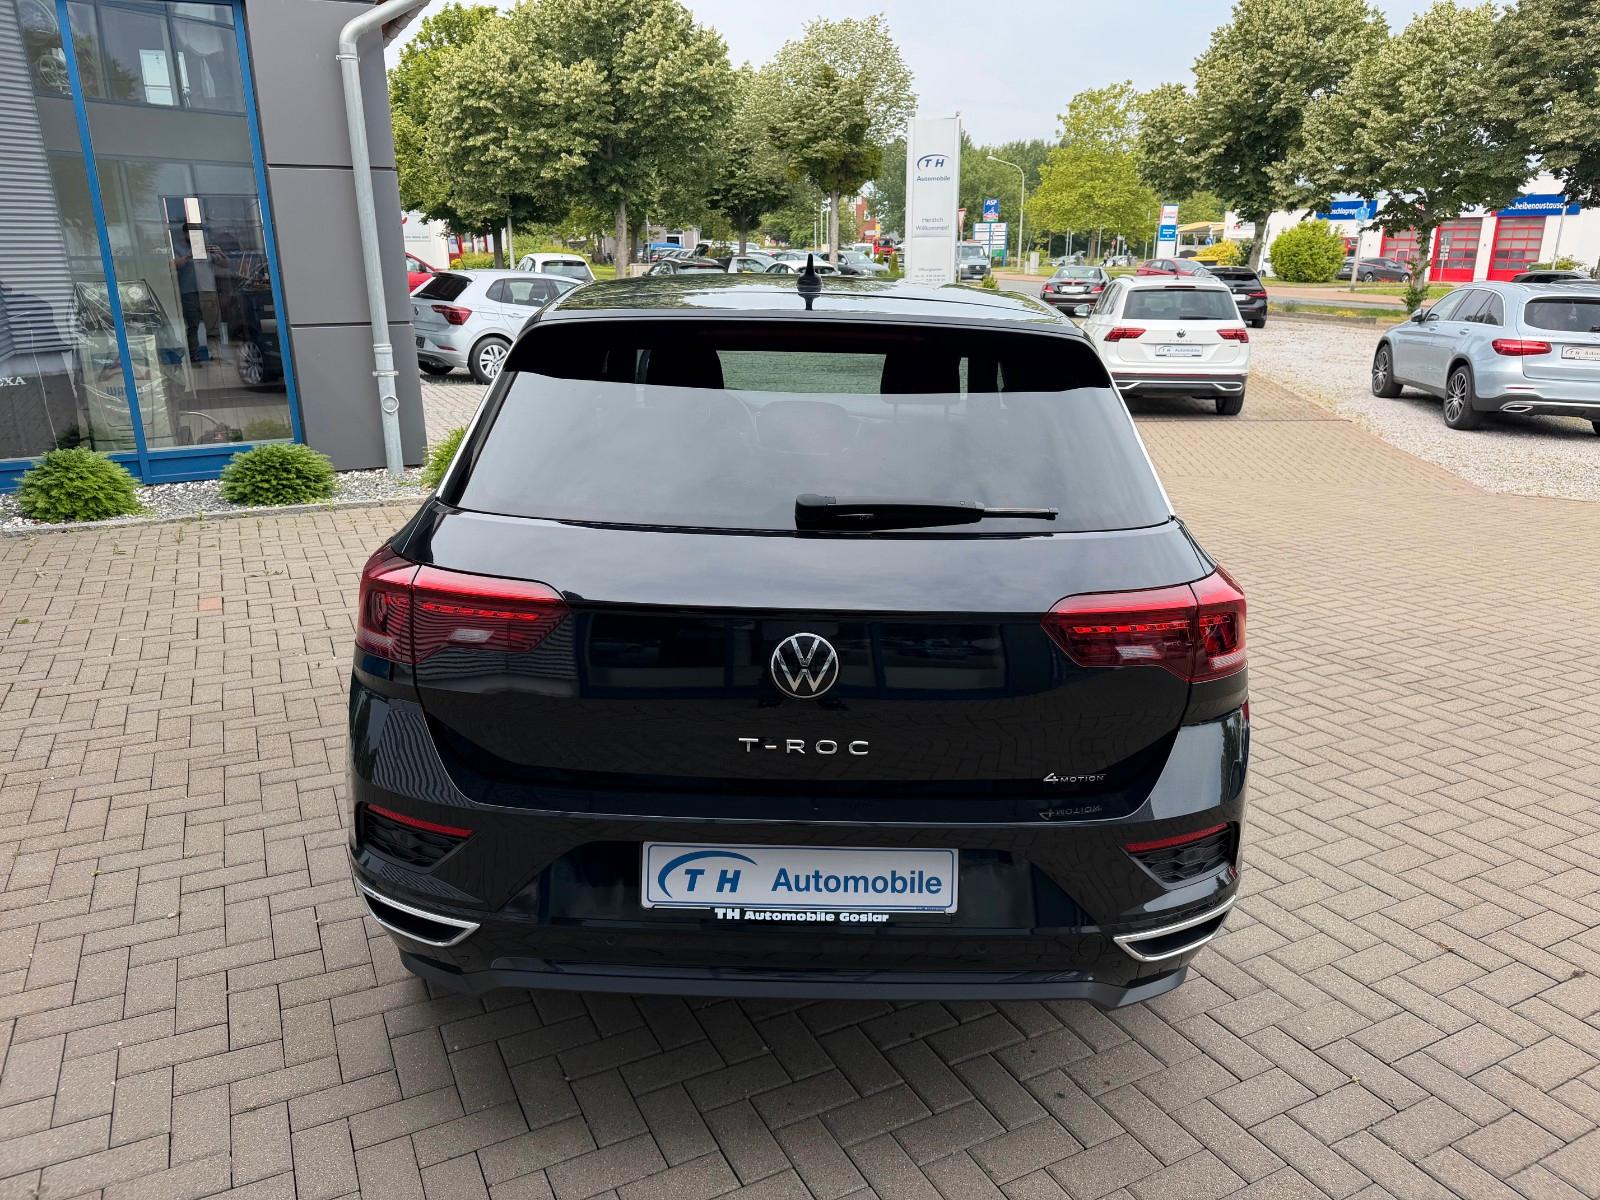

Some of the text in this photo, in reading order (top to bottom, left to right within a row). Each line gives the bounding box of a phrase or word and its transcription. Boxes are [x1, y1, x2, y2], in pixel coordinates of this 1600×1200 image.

[739, 737, 869, 756] T-ROC
[771, 867, 943, 895] Automobile
[713, 907, 890, 923] TH Automobile Goslar
